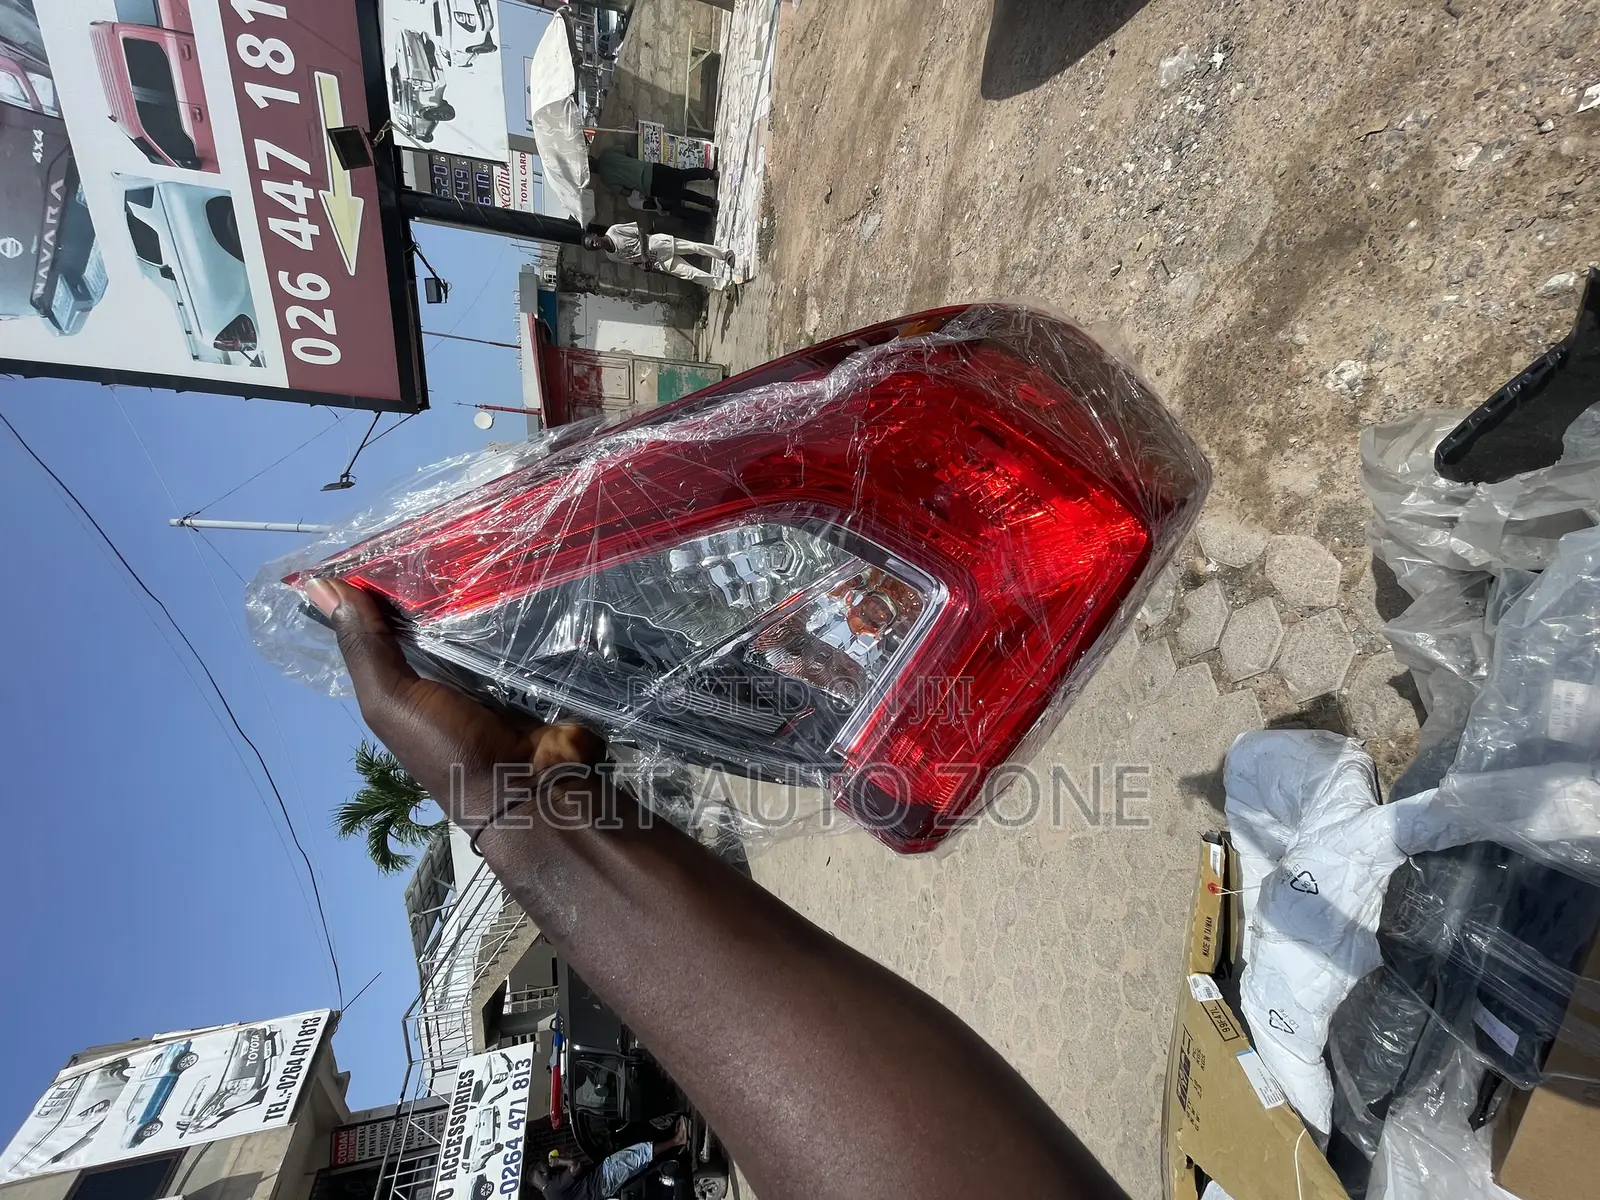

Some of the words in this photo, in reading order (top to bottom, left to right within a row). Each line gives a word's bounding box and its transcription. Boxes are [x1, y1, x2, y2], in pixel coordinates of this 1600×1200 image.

[229, 0, 301, 109] 181
[519, 152, 527, 176] CARD
[253, 139, 321, 251] 447
[520, 178, 528, 203] TOTAL
[33, 179, 64, 297] NAVARA
[277, 270, 342, 366] 026
[1204, 915, 1213, 936] TAIWAN
[1202, 942, 1210, 958] MADE
[297, 1015, 322, 1037] 813
[246, 1033, 260, 1067] TOYOTA
[289, 1037, 315, 1056] 471
[512, 1057, 531, 1091] 813
[439, 1069, 475, 1182] ACCESSORIES
[507, 1096, 528, 1131] 471
[358, 1126, 366, 1157] GENERAL
[368, 1124, 377, 1157] PRINTING
